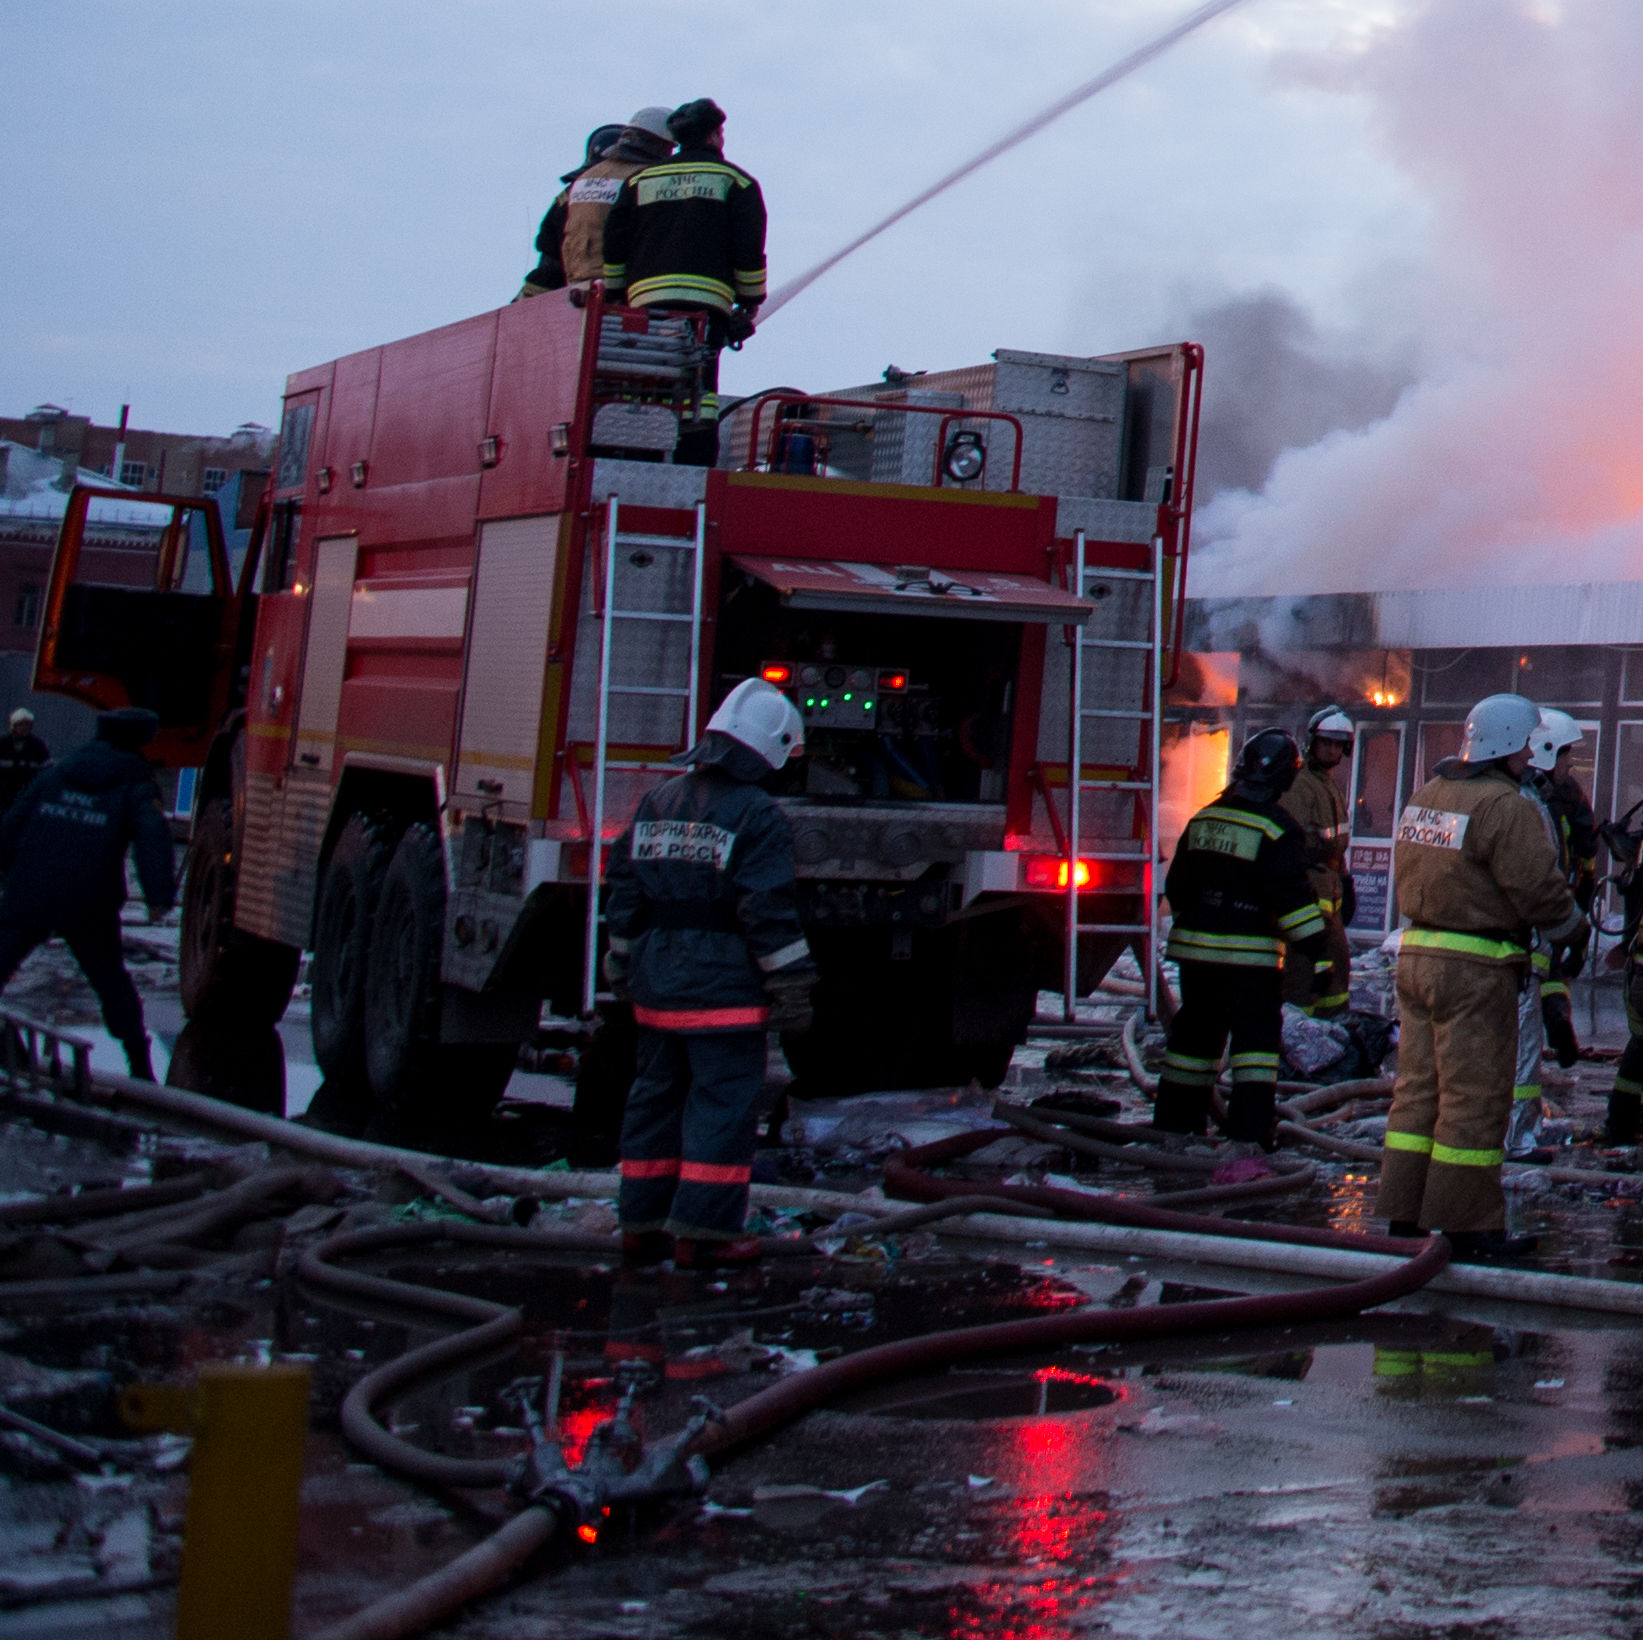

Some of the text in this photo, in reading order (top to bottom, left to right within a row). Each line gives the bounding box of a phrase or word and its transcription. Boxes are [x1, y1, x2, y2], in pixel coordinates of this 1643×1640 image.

[655, 186, 715, 200] РОССИИ
[1416, 808, 1443, 826] МЧС
[1401, 825, 1453, 847] РОССИИ
